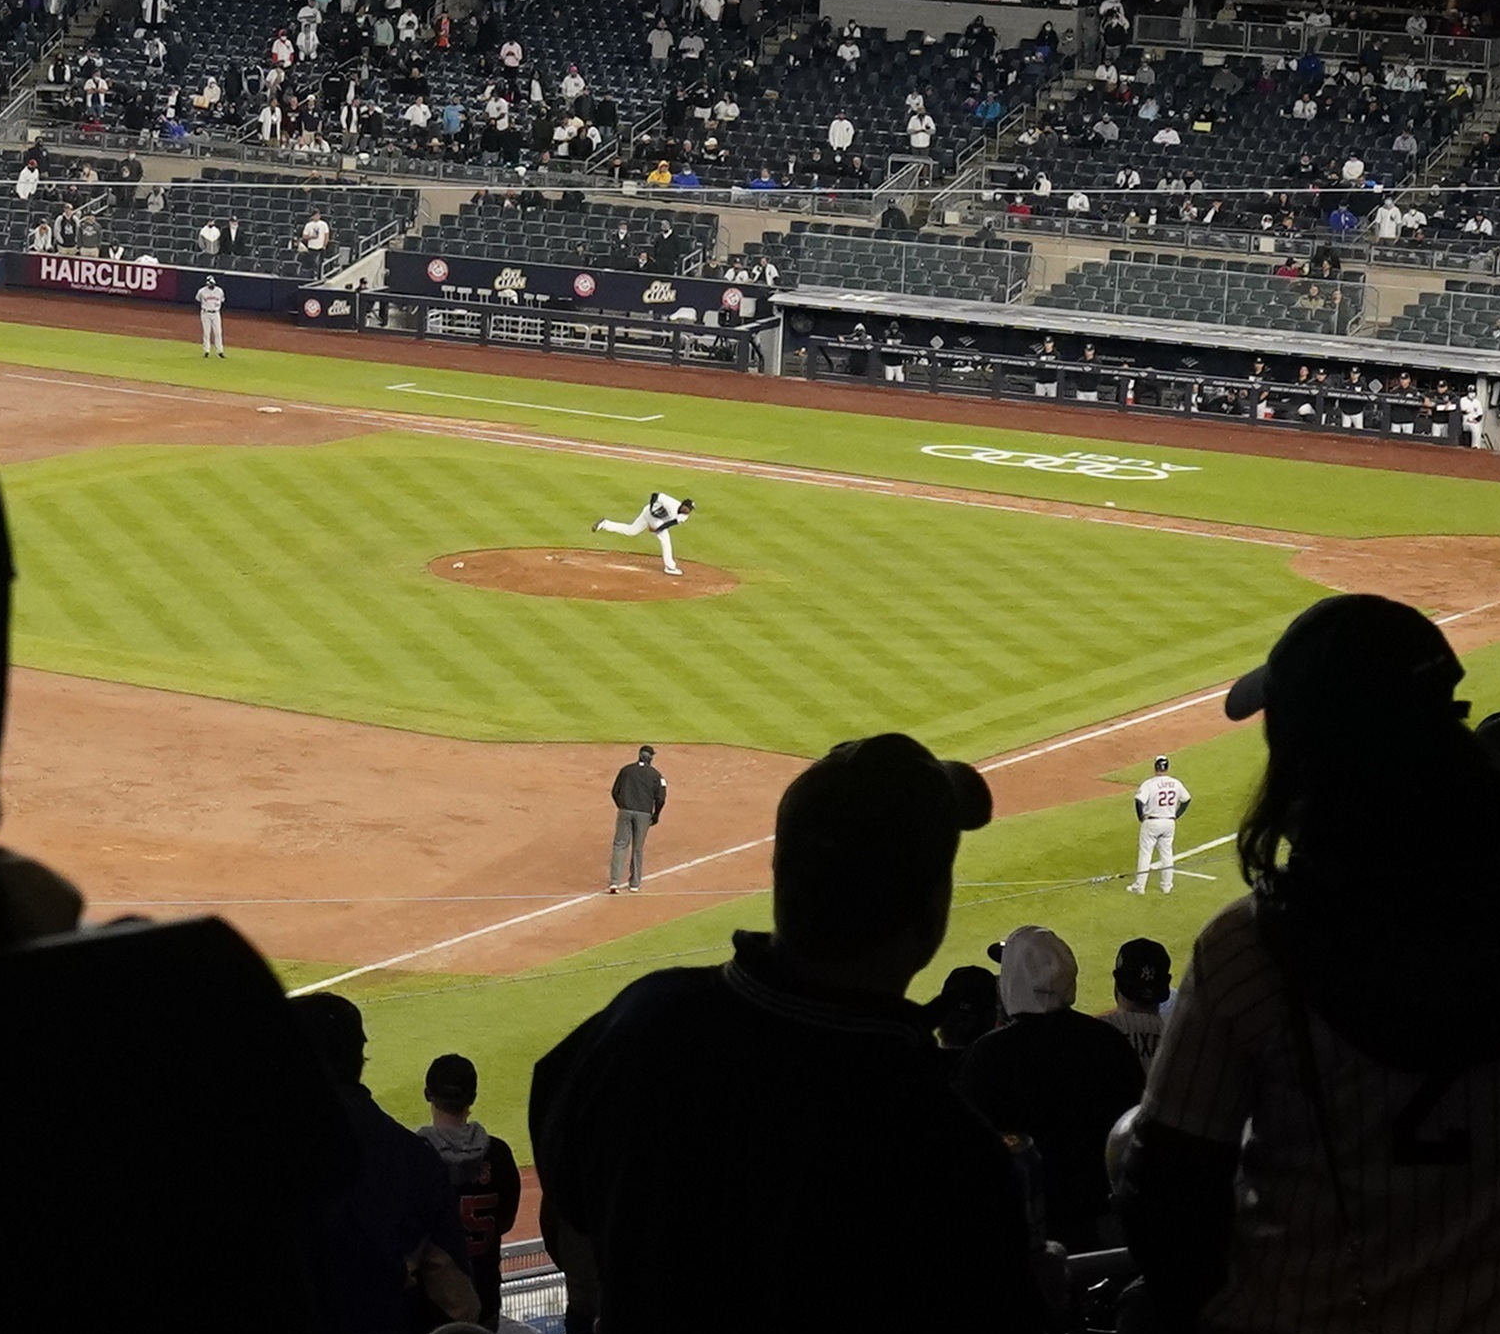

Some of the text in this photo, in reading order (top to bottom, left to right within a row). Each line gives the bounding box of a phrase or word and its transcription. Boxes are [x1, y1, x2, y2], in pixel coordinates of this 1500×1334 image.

[501, 267, 522, 278] OXI
[494, 276, 527, 292] CLEAN
[651, 280, 672, 292] OXI
[642, 289, 677, 304] CLEAN
[1062, 452, 1203, 471] Audi
[1158, 790, 1176, 806] 22
